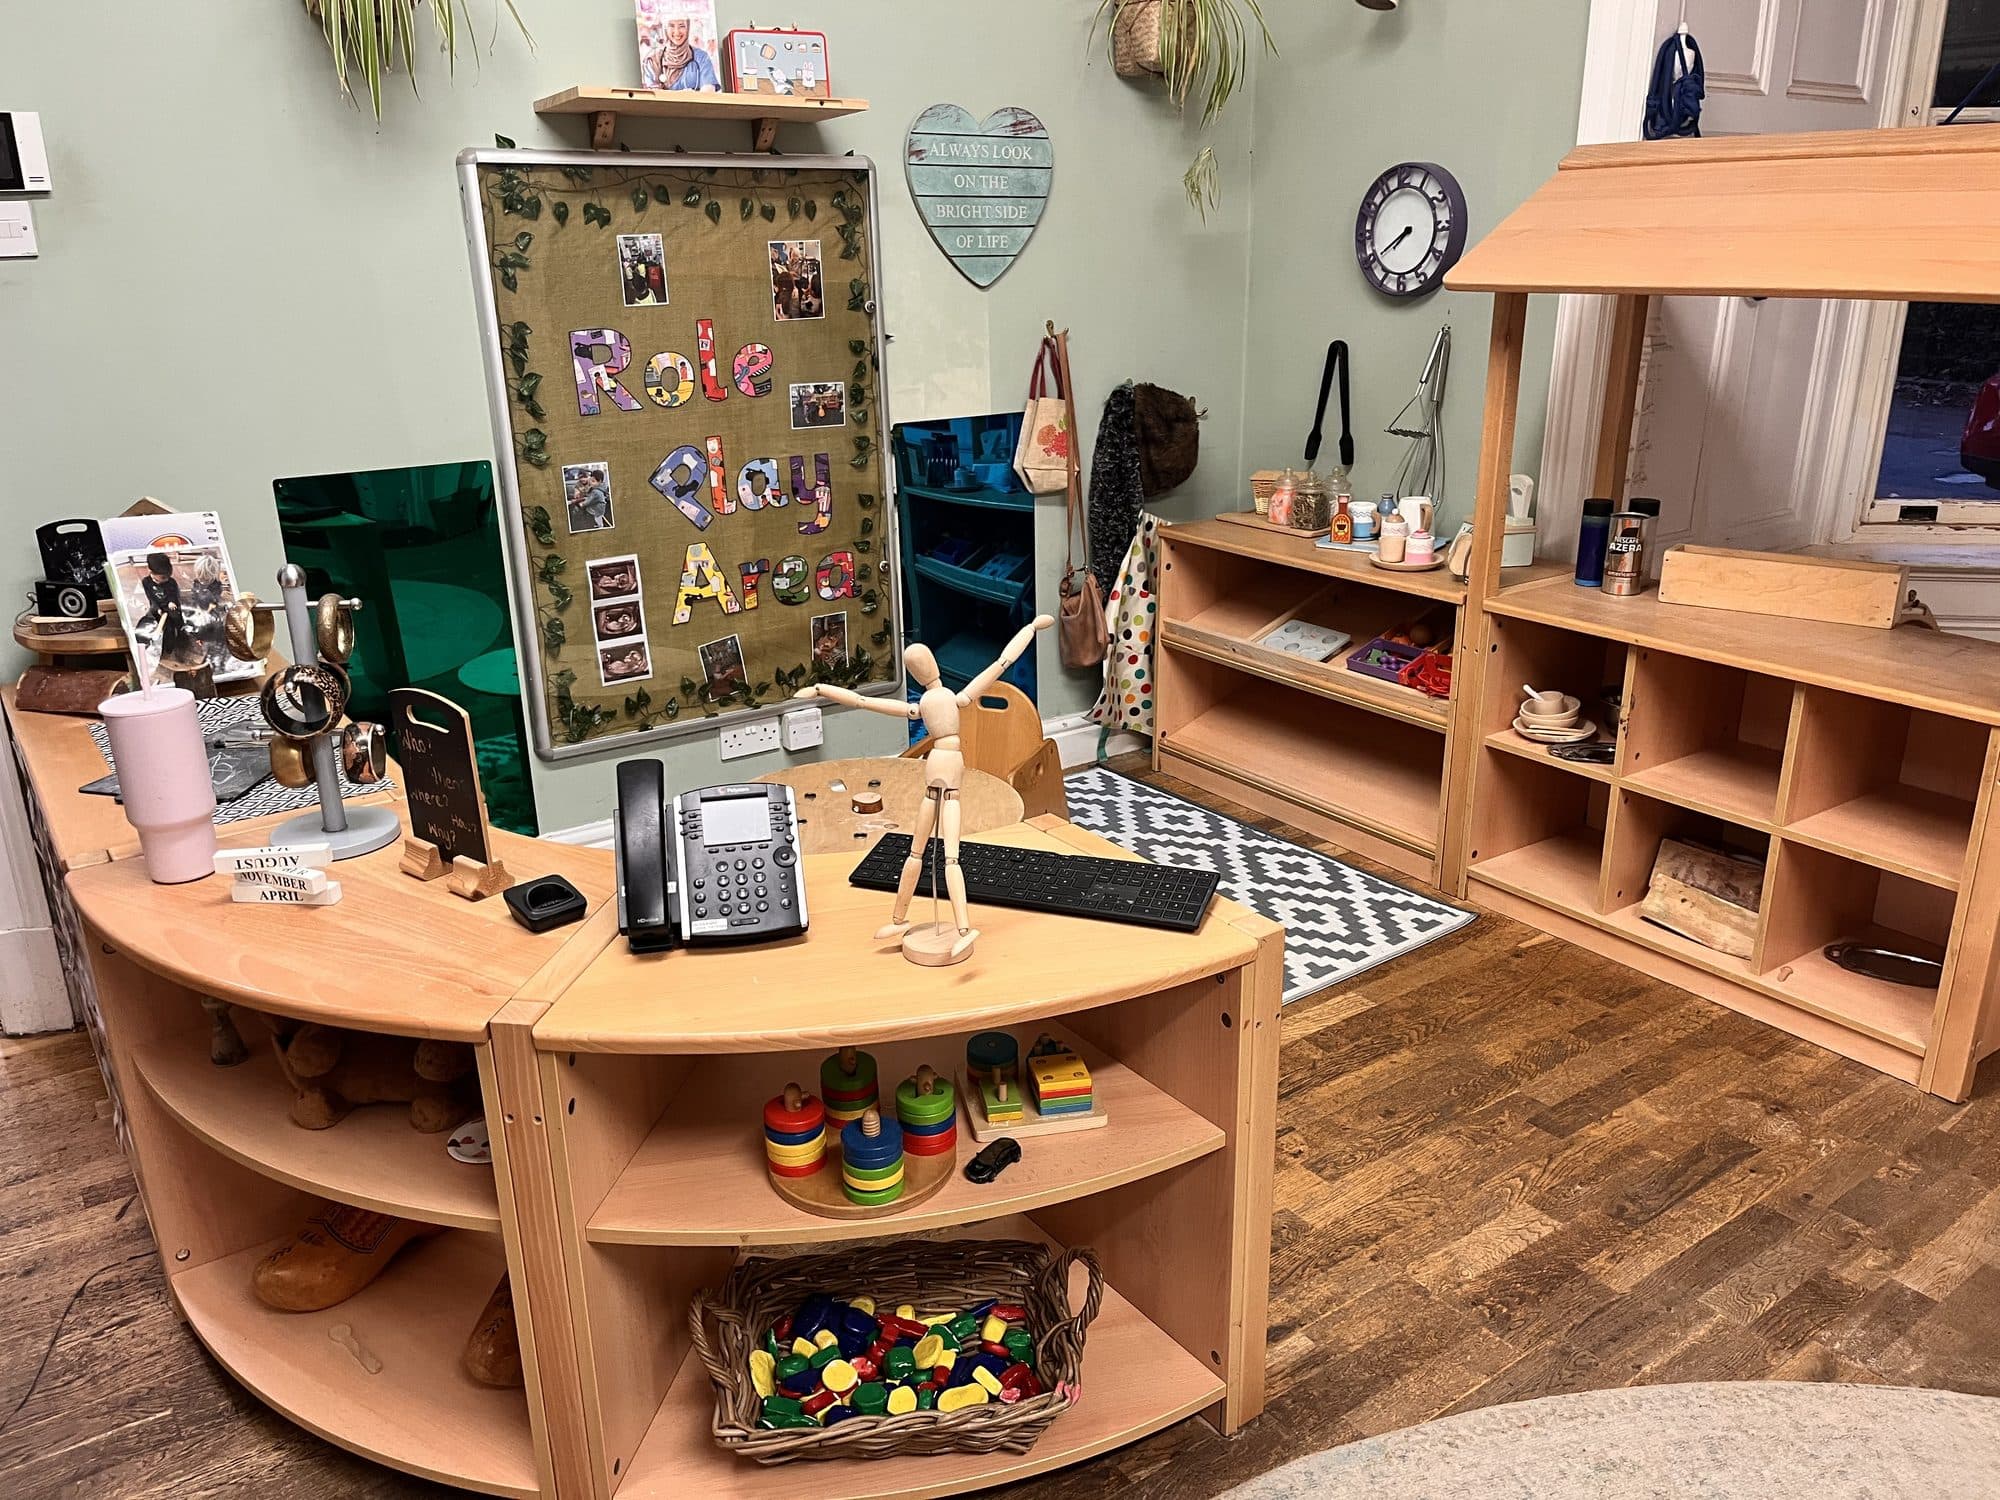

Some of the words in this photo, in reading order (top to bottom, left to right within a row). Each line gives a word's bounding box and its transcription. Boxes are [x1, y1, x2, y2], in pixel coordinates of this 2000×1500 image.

[929, 143, 989, 158] ALWAYS
[993, 146, 1032, 160] LOOK
[954, 174, 976, 188] ON
[980, 175, 1008, 188] THE
[936, 204, 991, 219] BRIGHT
[995, 206, 1028, 219] SIDE
[956, 235, 976, 249] OF
[978, 235, 1009, 249] LIFE
[568, 319, 774, 416] Role
[648, 436, 833, 534] Play
[1609, 542, 1642, 552] AZERA
[672, 542, 862, 626] Area
[234, 855, 300, 870] AUGUST
[240, 871, 307, 891] NOVEMBER
[260, 890, 304, 902] APRIL
